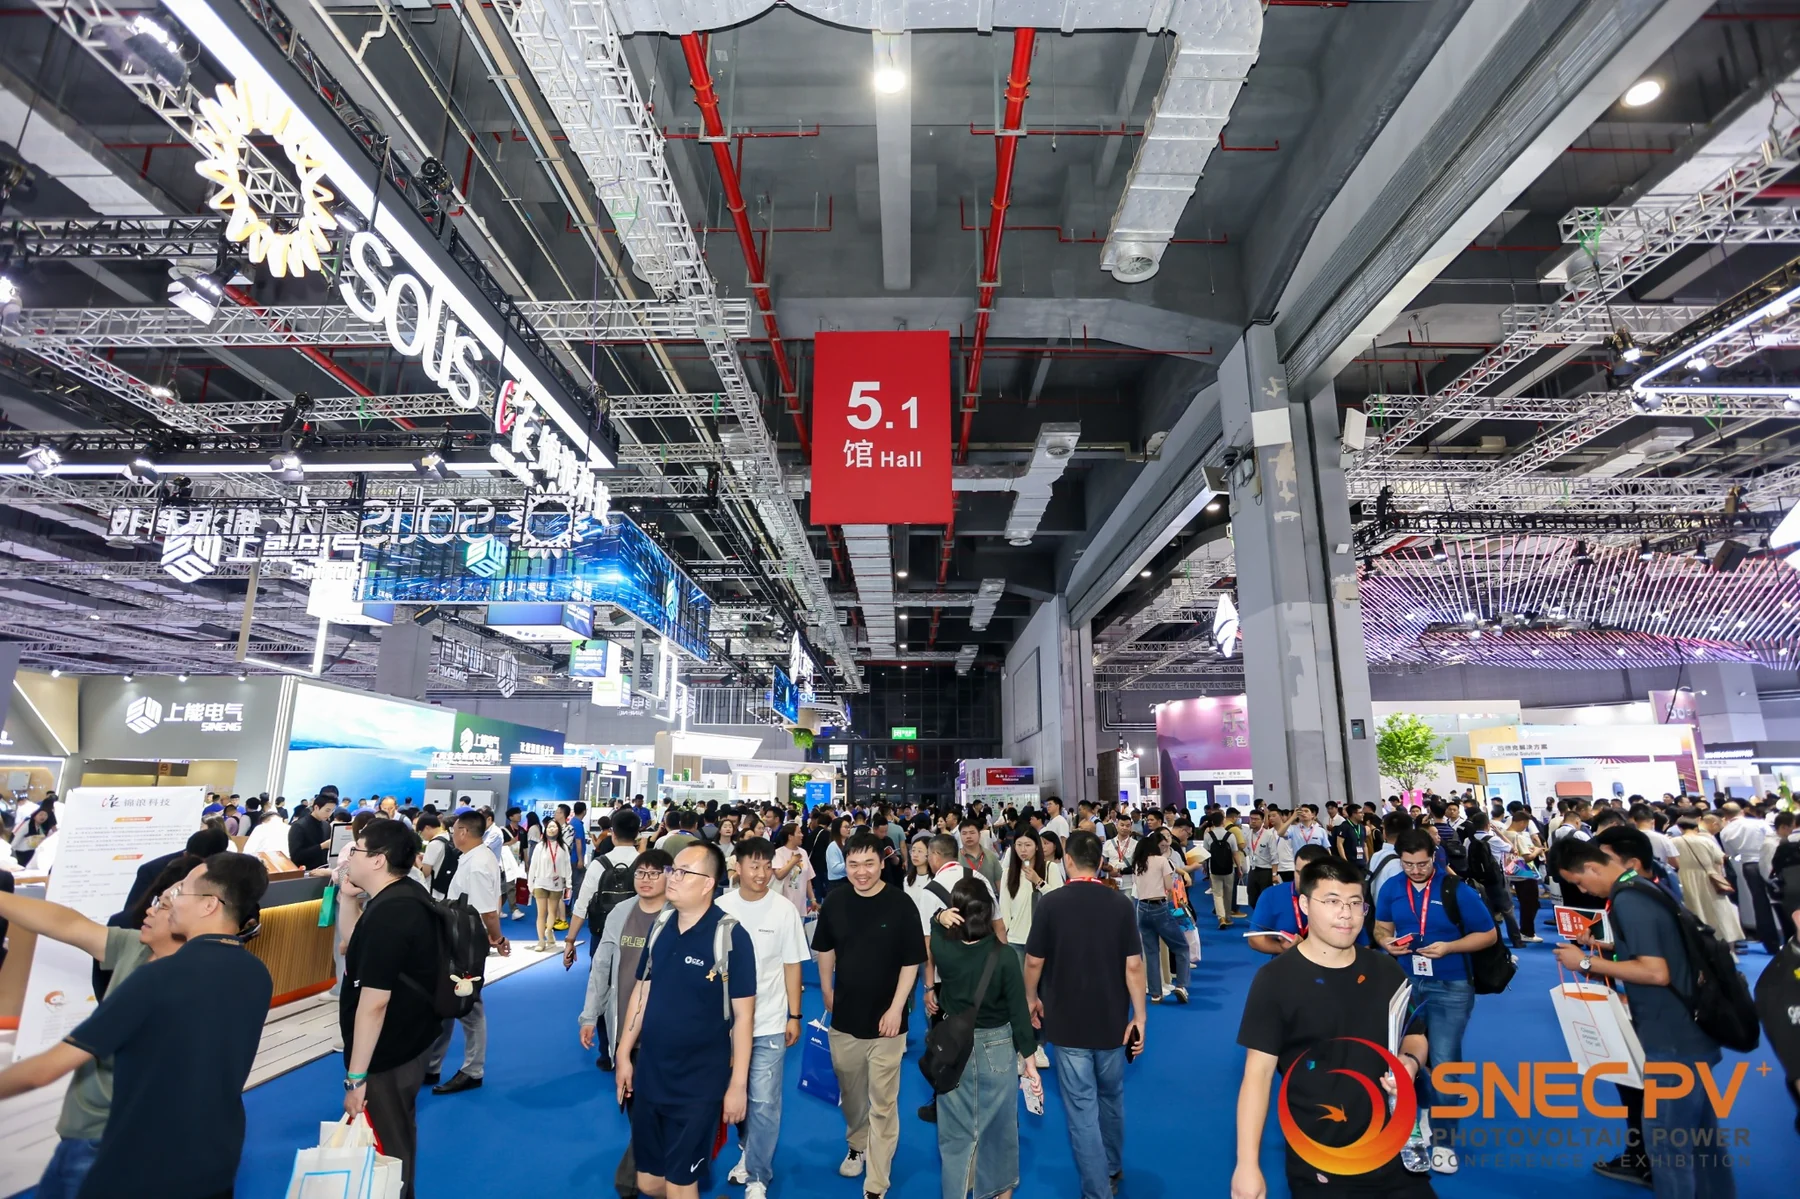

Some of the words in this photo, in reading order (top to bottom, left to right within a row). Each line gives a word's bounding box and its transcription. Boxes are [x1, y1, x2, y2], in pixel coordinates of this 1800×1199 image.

[846, 380, 919, 430] 5.1
[843, 439, 873, 468] 馆
[880, 450, 922, 468] Hall
[163, 702, 244, 722] 上能电气
[1223, 708, 1246, 733] 乐
[200, 722, 242, 732] SINENG
